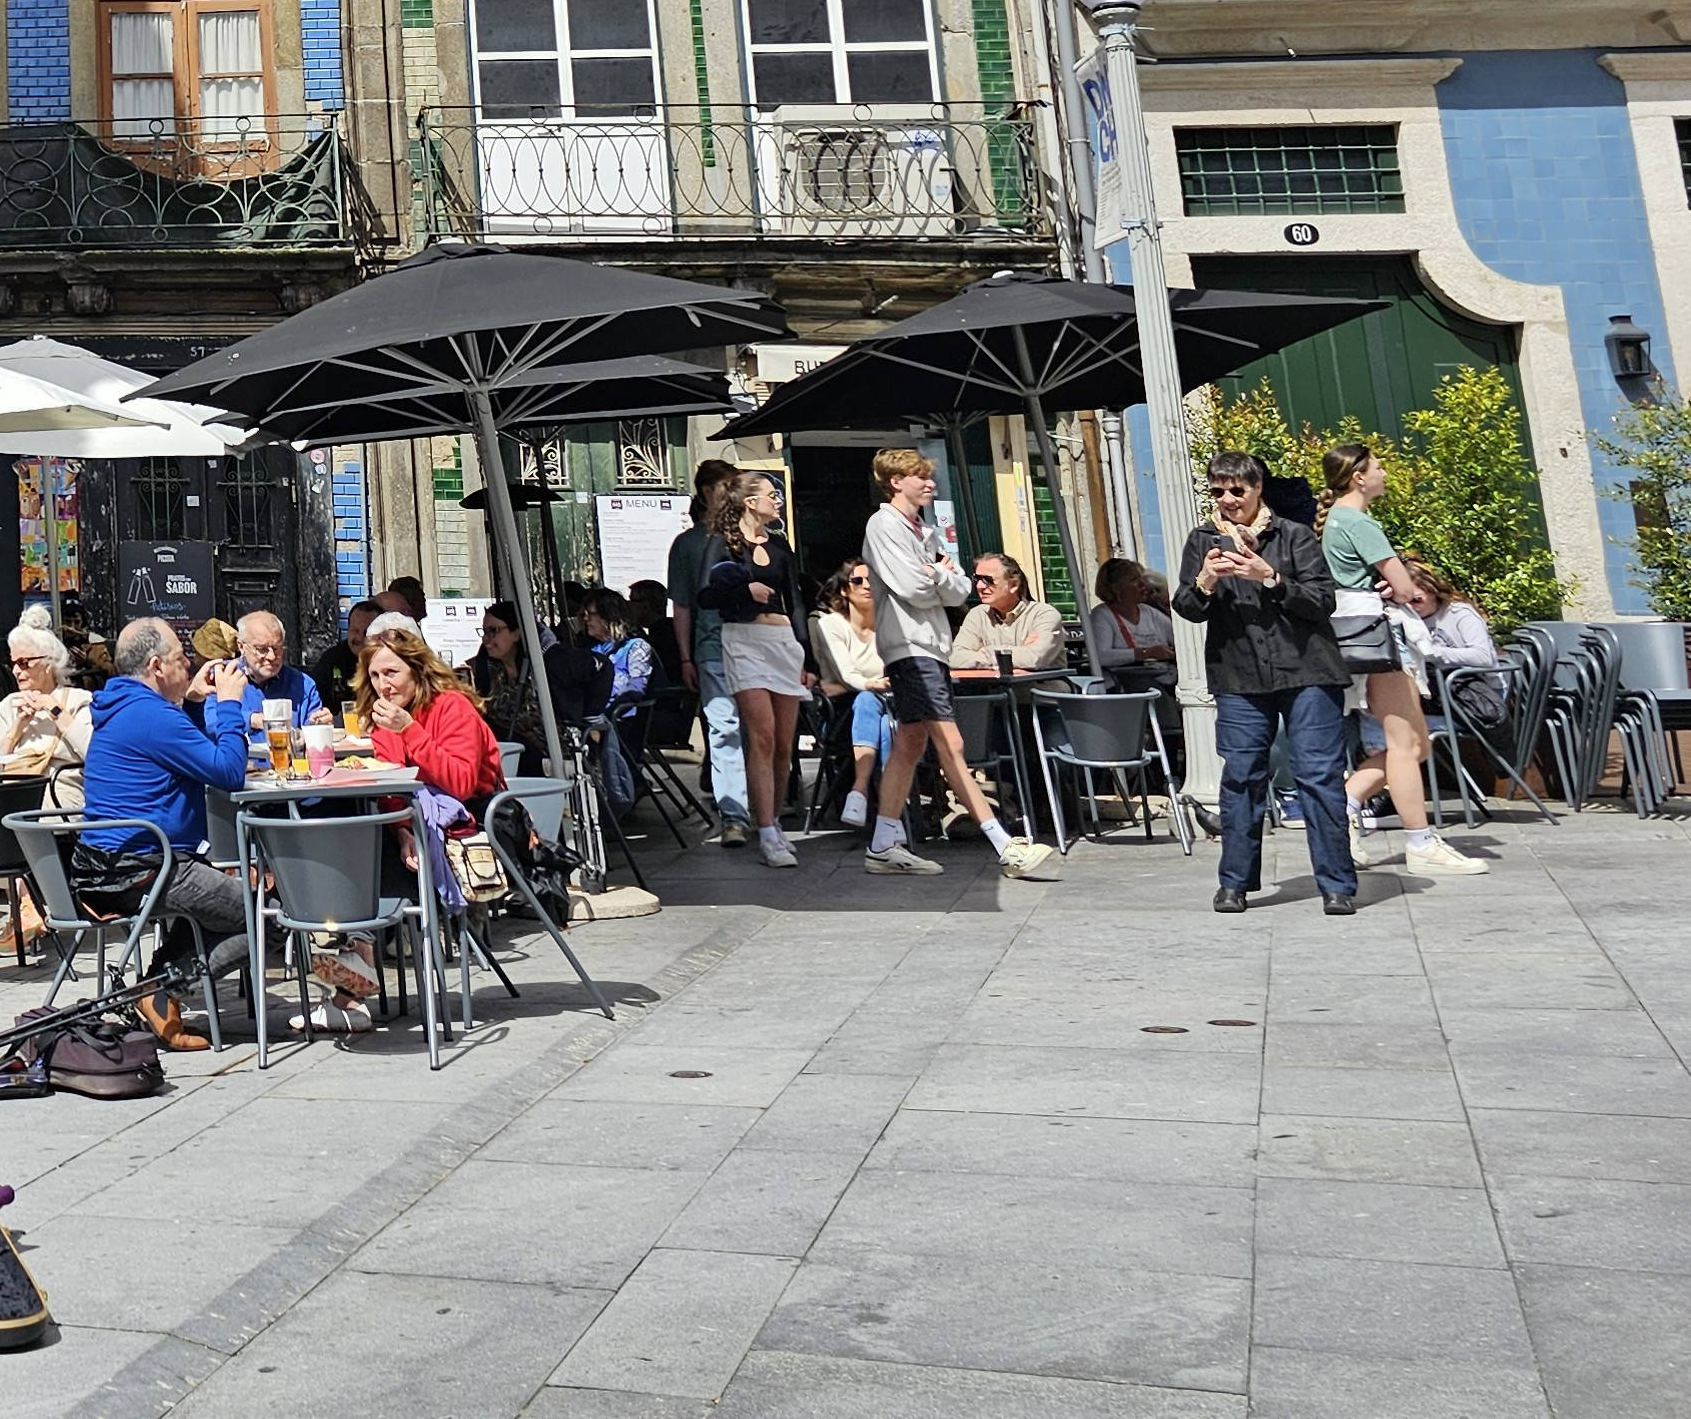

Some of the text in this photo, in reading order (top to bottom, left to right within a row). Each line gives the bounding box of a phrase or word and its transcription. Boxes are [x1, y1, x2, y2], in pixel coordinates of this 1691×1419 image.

[1292, 225, 1312, 242] 60
[626, 500, 658, 508] MENU
[166, 581, 198, 594] SABOR
